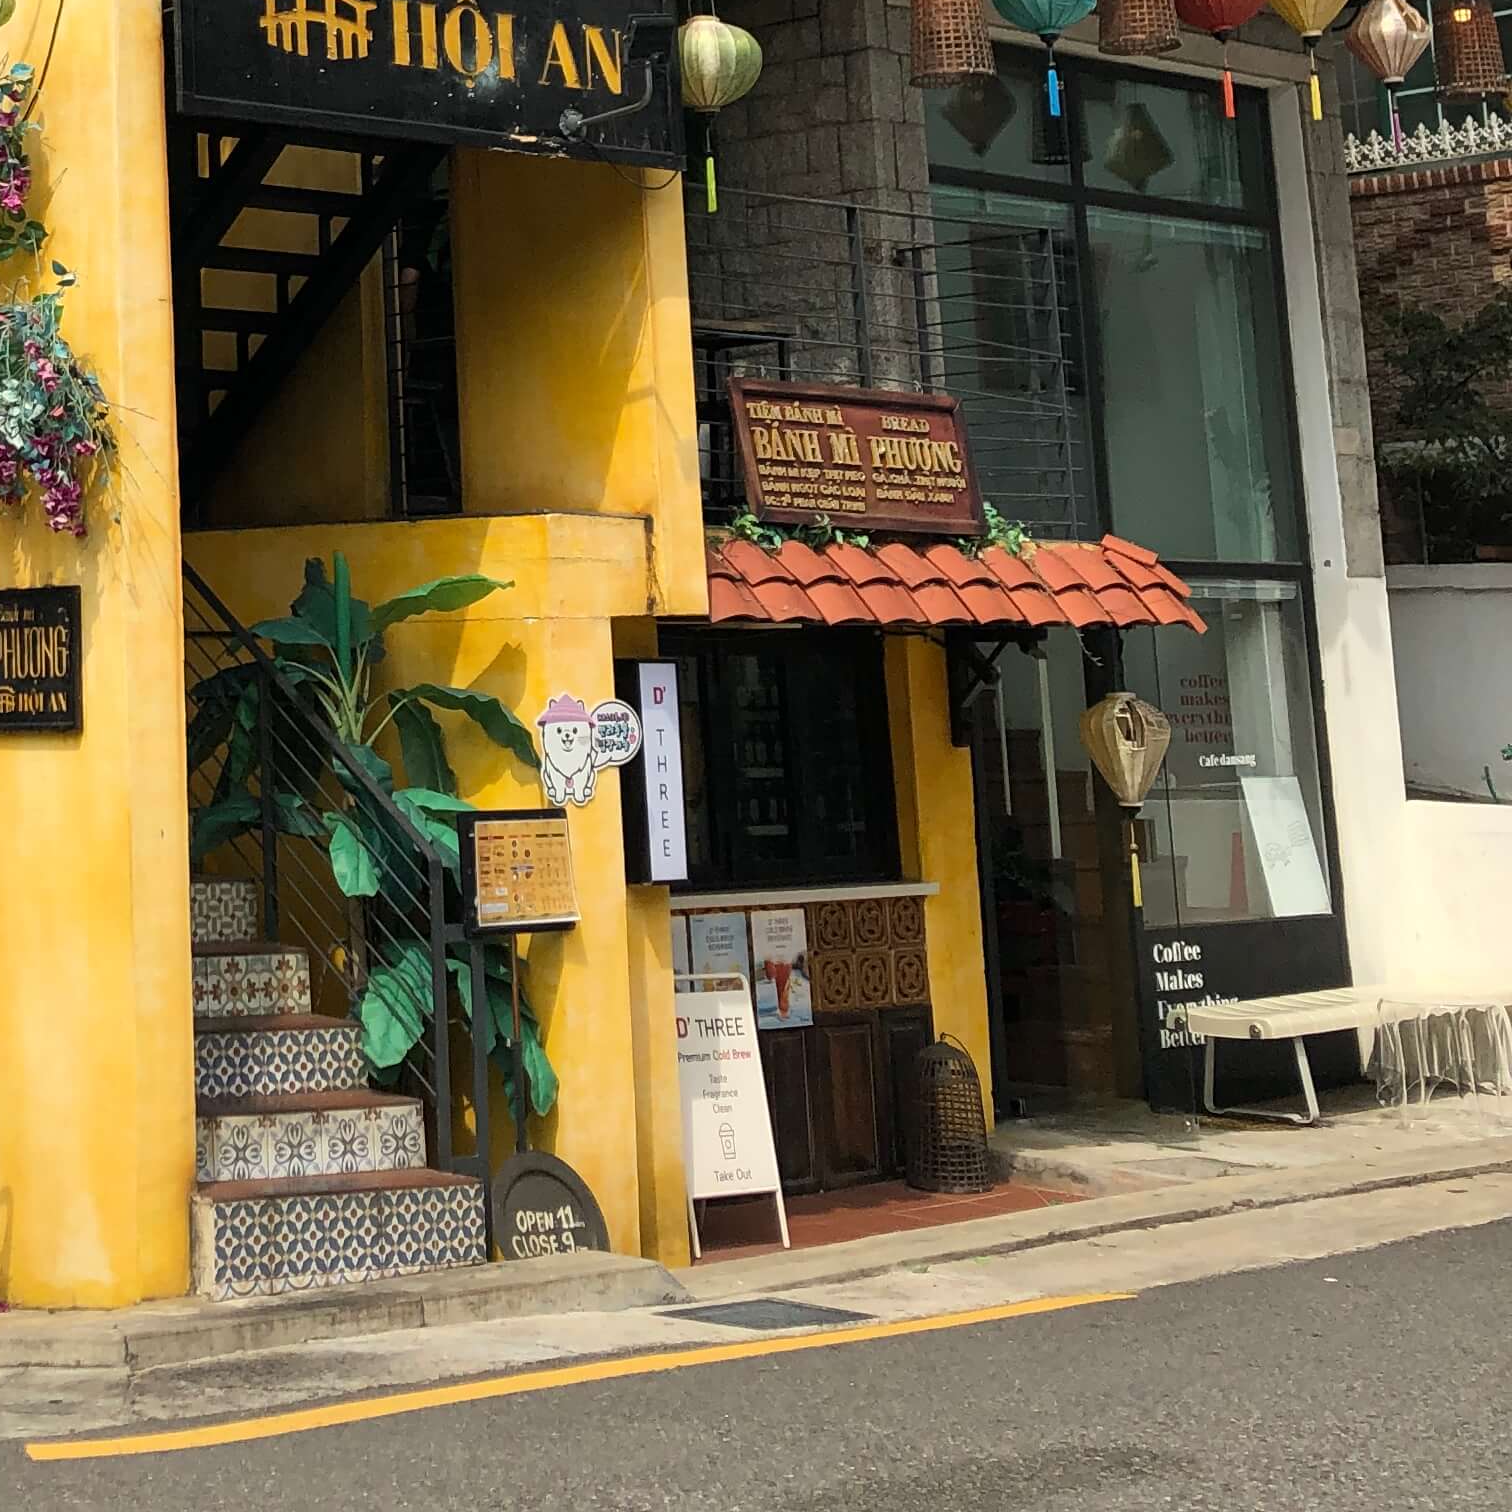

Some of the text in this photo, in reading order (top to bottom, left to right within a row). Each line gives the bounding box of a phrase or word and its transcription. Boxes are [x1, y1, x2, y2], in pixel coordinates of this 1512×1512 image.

[539, 20, 625, 96] AN
[784, 401, 824, 424] BÁNH
[879, 415, 930, 433] BREAD
[750, 420, 824, 463] BÁNH
[826, 426, 863, 466] MÌ
[1180, 674, 1225, 689] coffee
[1199, 753, 1219, 767] Cafe
[655, 728, 671, 857] THREE
[1153, 940, 1201, 963] Coffee
[1155, 969, 1204, 991] Makes
[694, 1016, 745, 1038] THREE
[677, 1048, 752, 1064] Premium Cold Brew
[708, 1073, 728, 1084] Taste
[702, 1088, 739, 1101] Fragrance
[712, 1103, 733, 1114] Clean
[713, 1168, 753, 1183] Take Out
